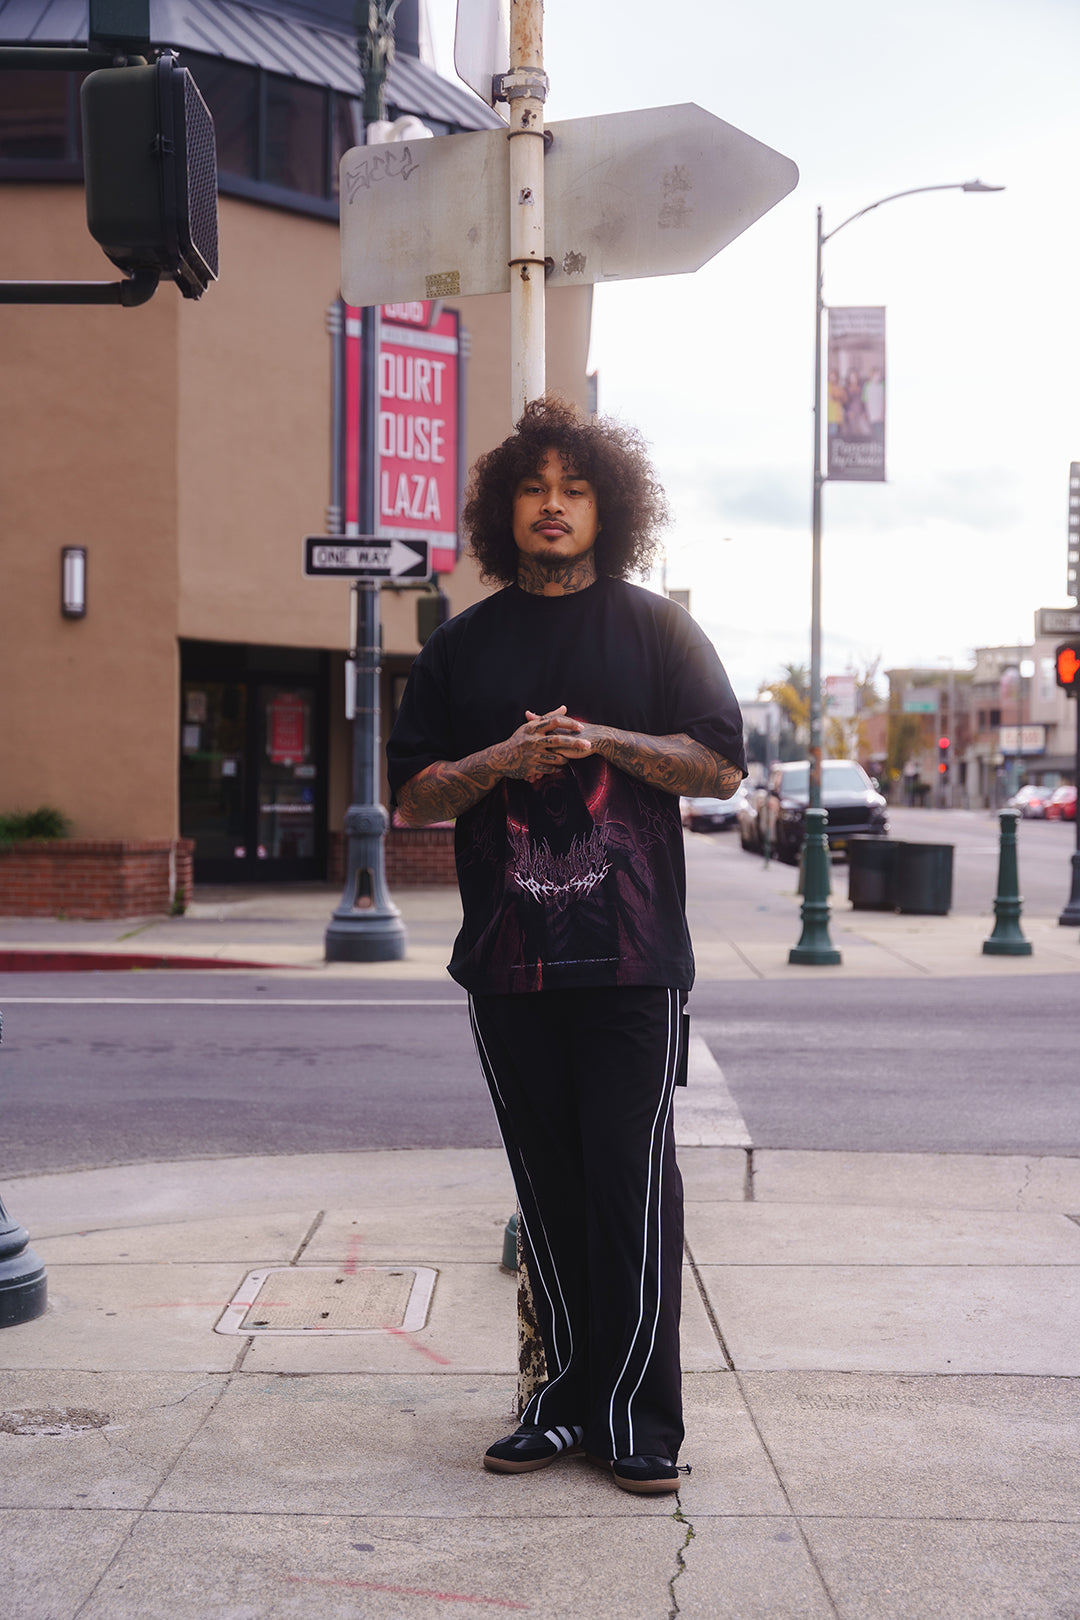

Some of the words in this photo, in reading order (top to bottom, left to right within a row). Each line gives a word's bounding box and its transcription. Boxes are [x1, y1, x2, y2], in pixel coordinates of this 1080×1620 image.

[379, 353, 446, 405] OURT
[379, 411, 445, 464] OUSE
[381, 470, 441, 521] LAZA
[317, 547, 351, 565] ONE
[358, 548, 391, 565] WAY
